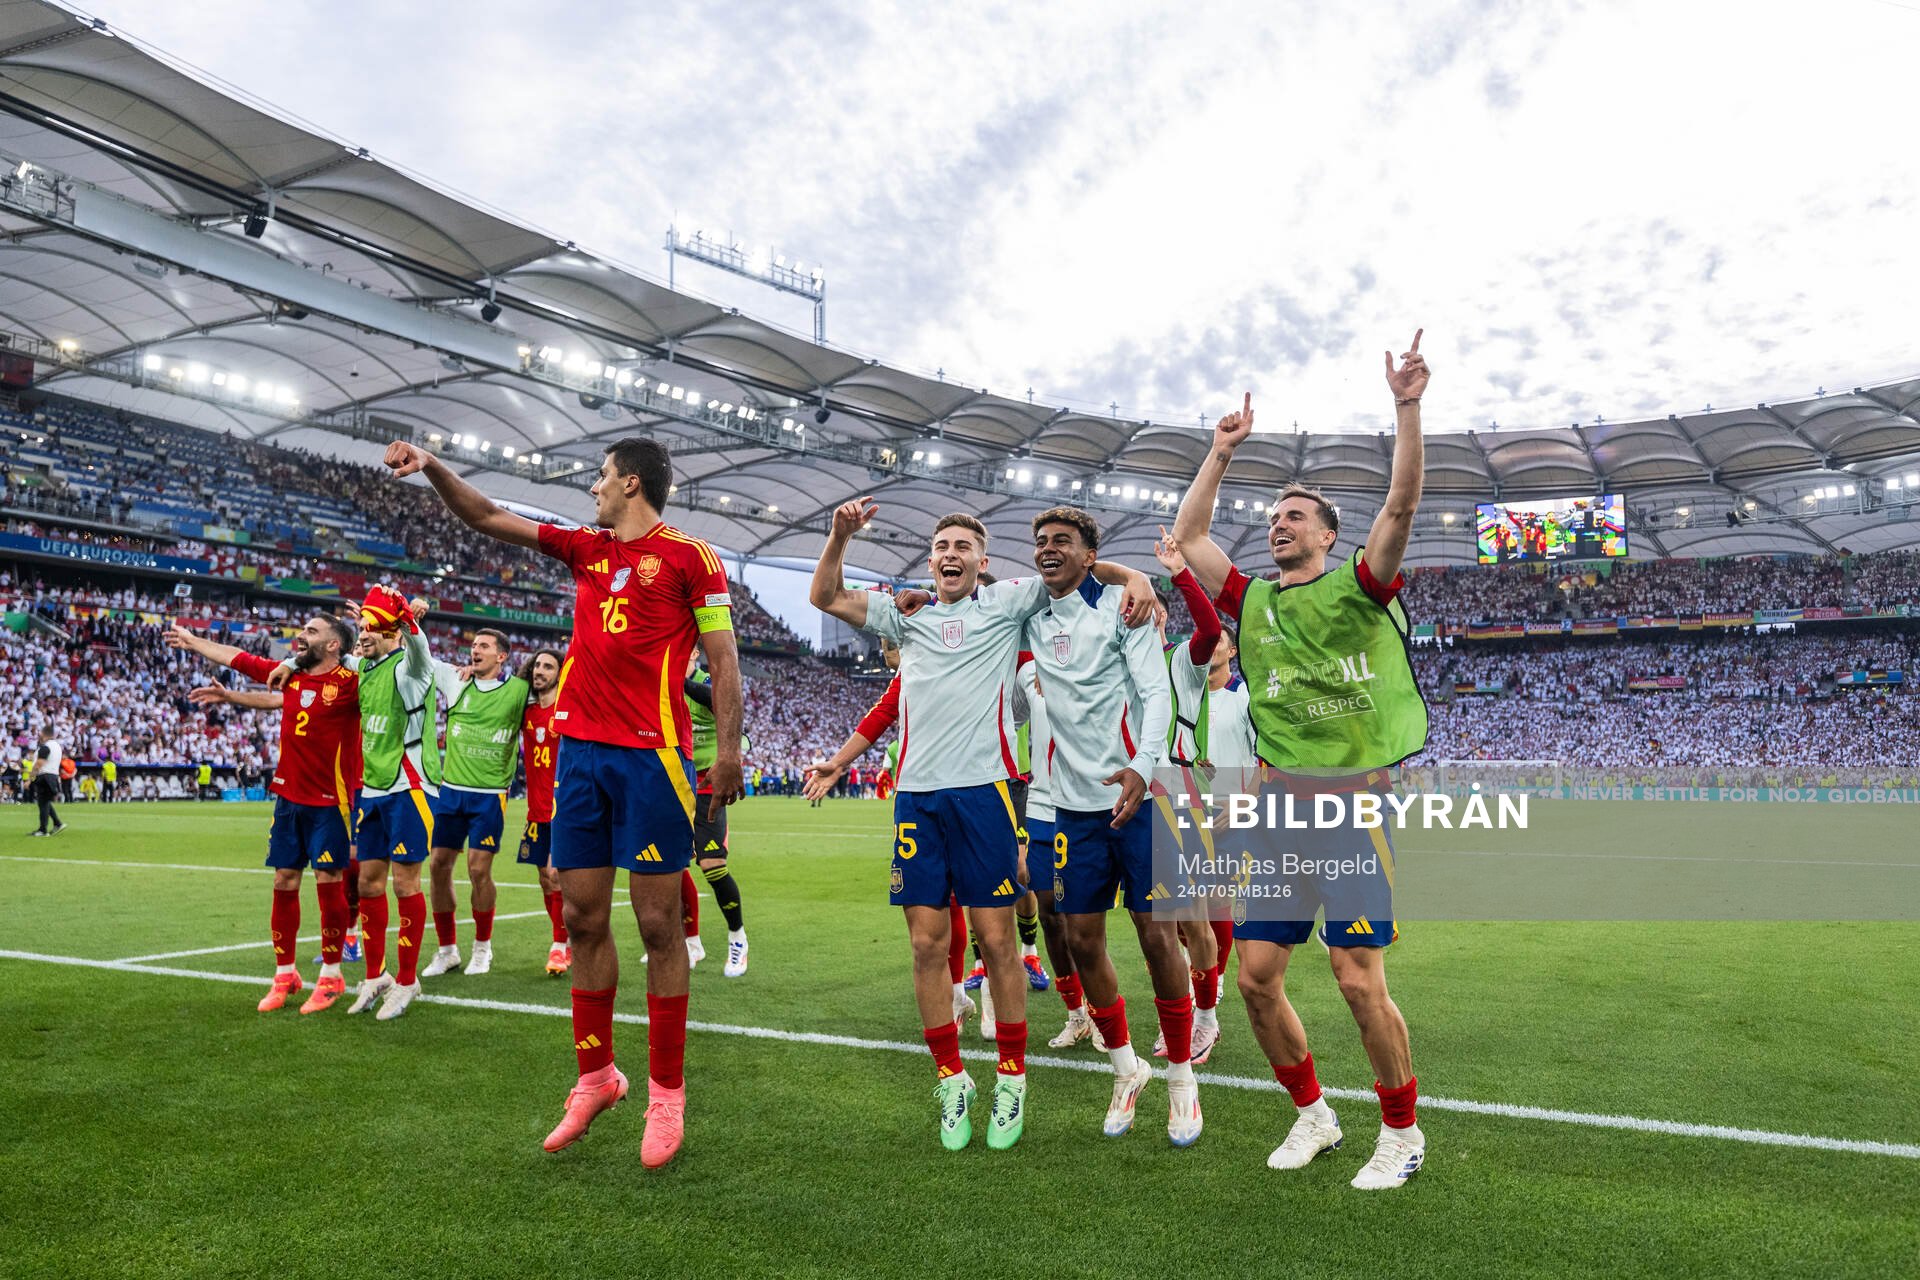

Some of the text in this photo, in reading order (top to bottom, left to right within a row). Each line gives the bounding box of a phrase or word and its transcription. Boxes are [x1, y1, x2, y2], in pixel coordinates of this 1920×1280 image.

[41, 540, 79, 557] UEFA
[501, 608, 565, 625] STUTTGART
[599, 596, 629, 634] 16
[1307, 695, 1369, 718] RESPEC
[295, 711, 309, 736] 2
[533, 746, 551, 768] 24
[1575, 785, 1633, 800] NEVER
[1643, 786, 1709, 801] SETTLE
[1719, 787, 1758, 802] FOR
[1769, 788, 1818, 803] NO.2
[1828, 788, 1920, 804] GLOBALL
